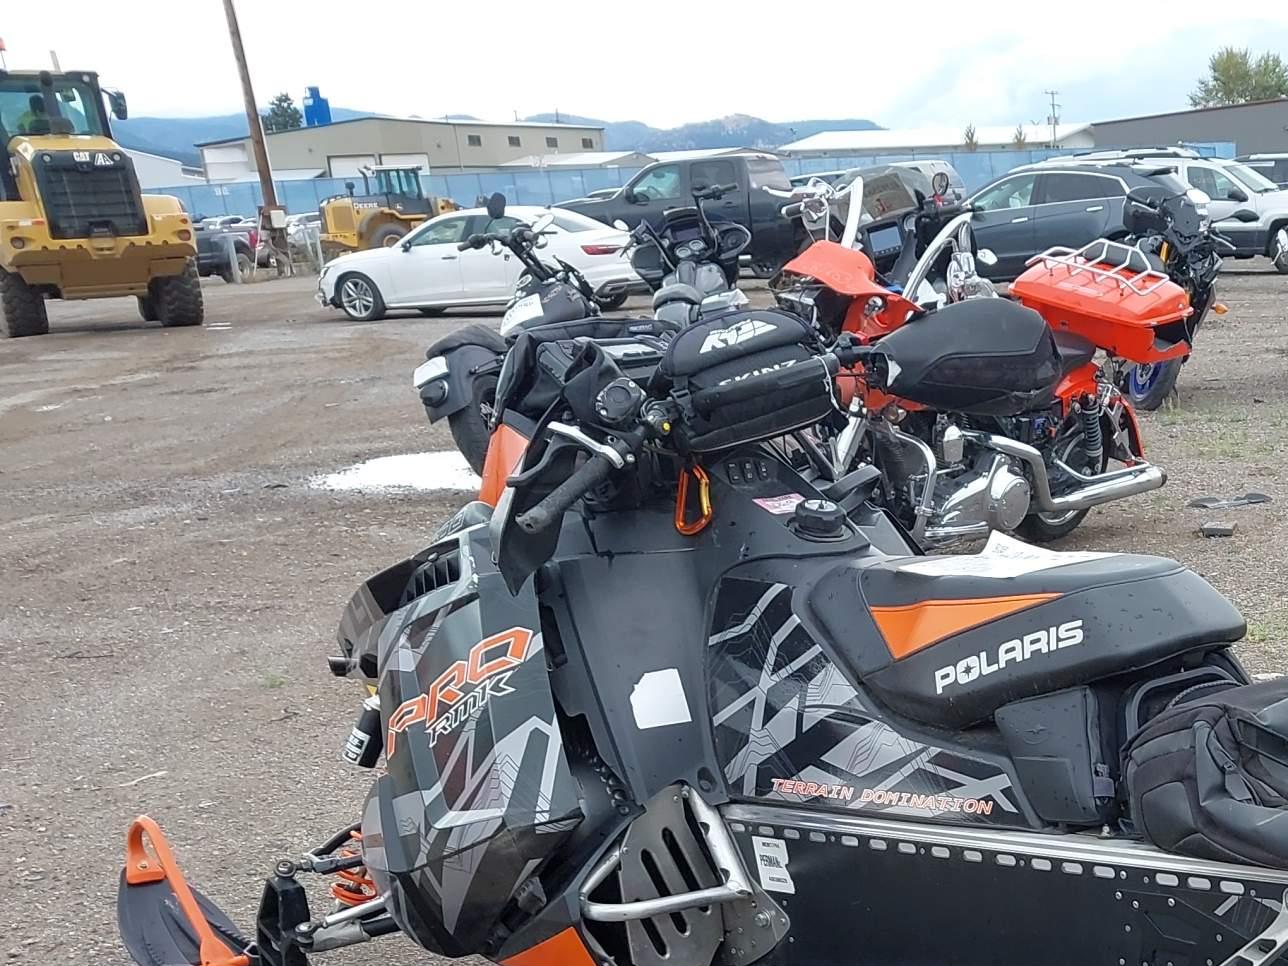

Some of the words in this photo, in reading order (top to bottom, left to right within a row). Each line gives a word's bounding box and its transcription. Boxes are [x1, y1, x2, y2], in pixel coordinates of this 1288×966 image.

[387, 626, 533, 760] PRO
[934, 619, 1084, 695] POLARIS
[771, 777, 854, 800] TERRAIN
[860, 788, 994, 815] DOMINATION
